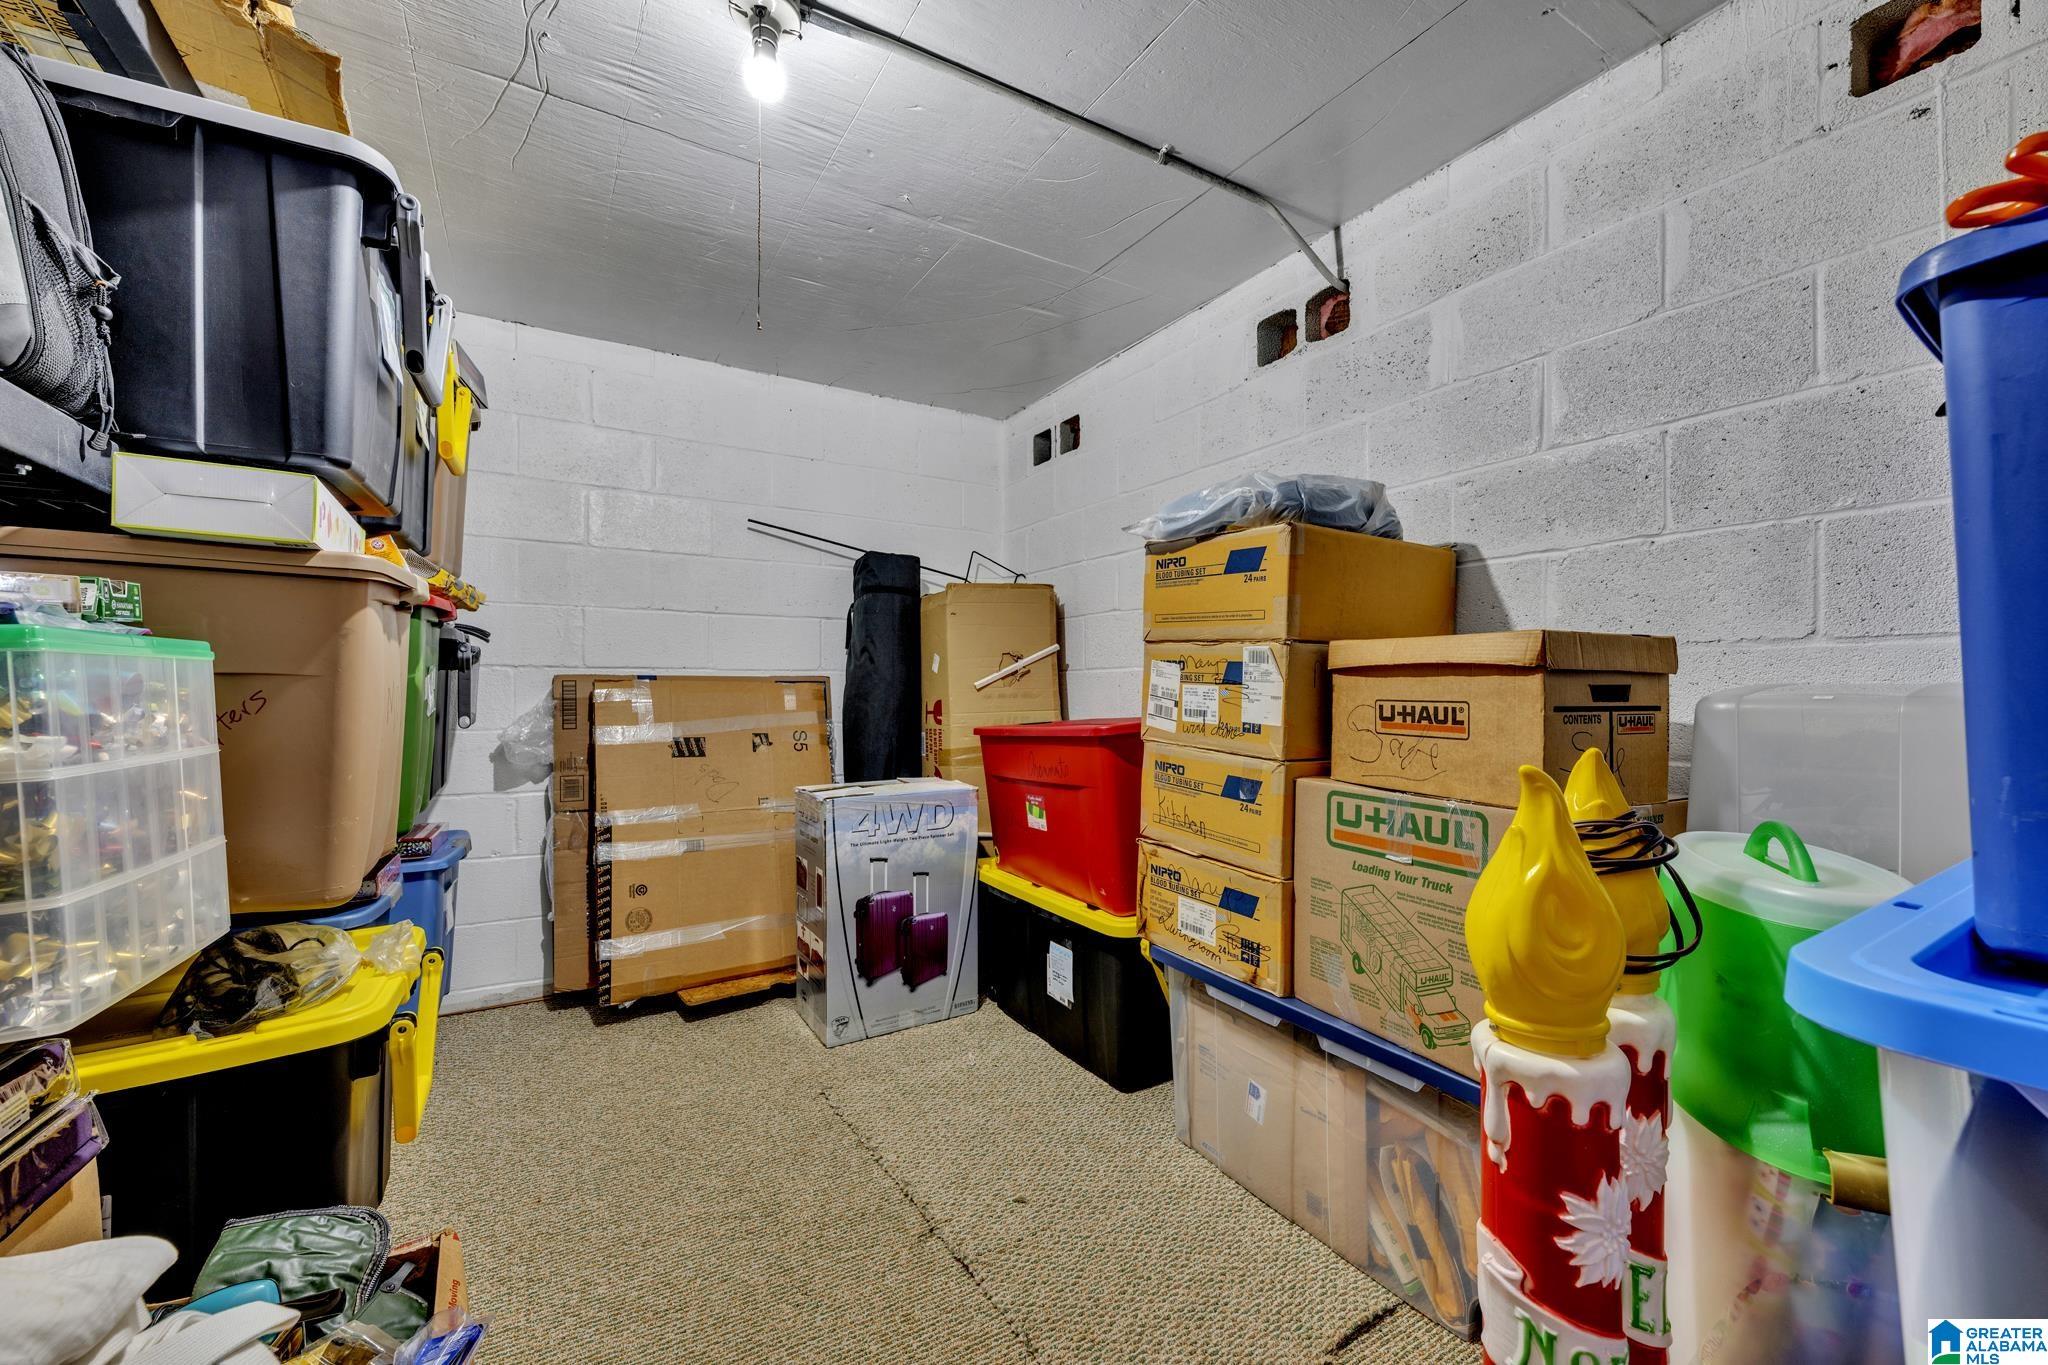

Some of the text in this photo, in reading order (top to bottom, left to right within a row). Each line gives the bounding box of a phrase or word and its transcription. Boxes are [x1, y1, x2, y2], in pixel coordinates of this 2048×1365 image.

[1156, 556, 1186, 570] NIPRO
[1156, 568, 1206, 580] BLOOD TUBING SET
[1244, 574, 1252, 583] 24
[1378, 704, 1464, 726] U-HAUL
[1563, 714, 1602, 725] CONTENTS
[1618, 716, 1654, 727] U-HAUL
[793, 730, 808, 752] S5
[1155, 760, 1185, 776] NIPRO
[1154, 772, 1204, 790] BLOOD TUBING SET
[1240, 803, 1248, 812] 24
[852, 799, 954, 837] 4WD
[1336, 801, 1474, 850] U-HAUL
[1150, 864, 1182, 882] NIPRO
[1352, 860, 1453, 894] Loading Your Truck
[1150, 876, 1201, 898] BLOOD TUBING SET
[1218, 945, 1227, 955] 24
[1420, 974, 1449, 984] U-HAUL
